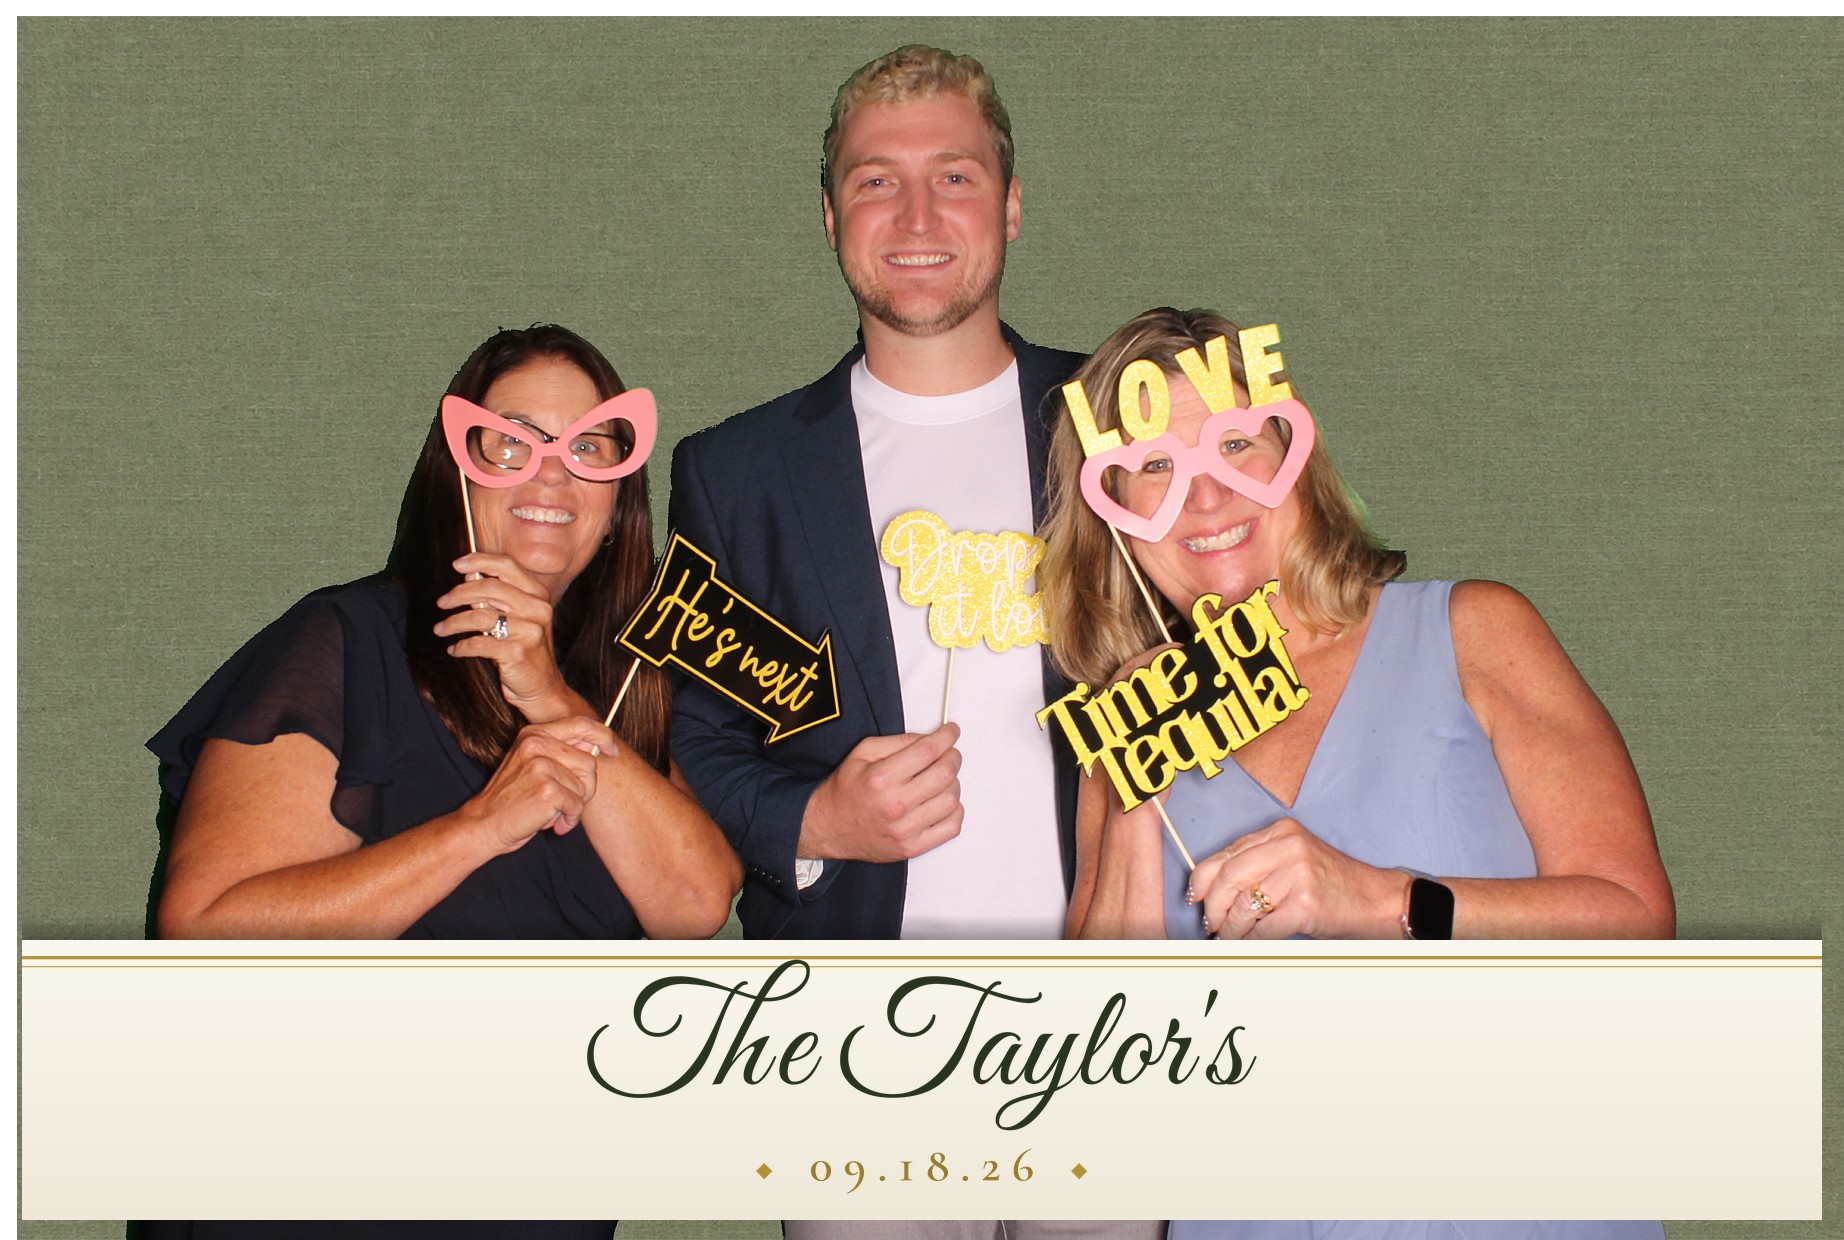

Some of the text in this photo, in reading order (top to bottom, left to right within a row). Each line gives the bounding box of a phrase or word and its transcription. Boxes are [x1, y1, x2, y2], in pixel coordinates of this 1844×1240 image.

[1062, 323, 1293, 458] LOVE
[891, 519, 1038, 595] Drop
[938, 583, 979, 637] it
[645, 568, 818, 713] He's next
[1036, 580, 1289, 765] Time for
